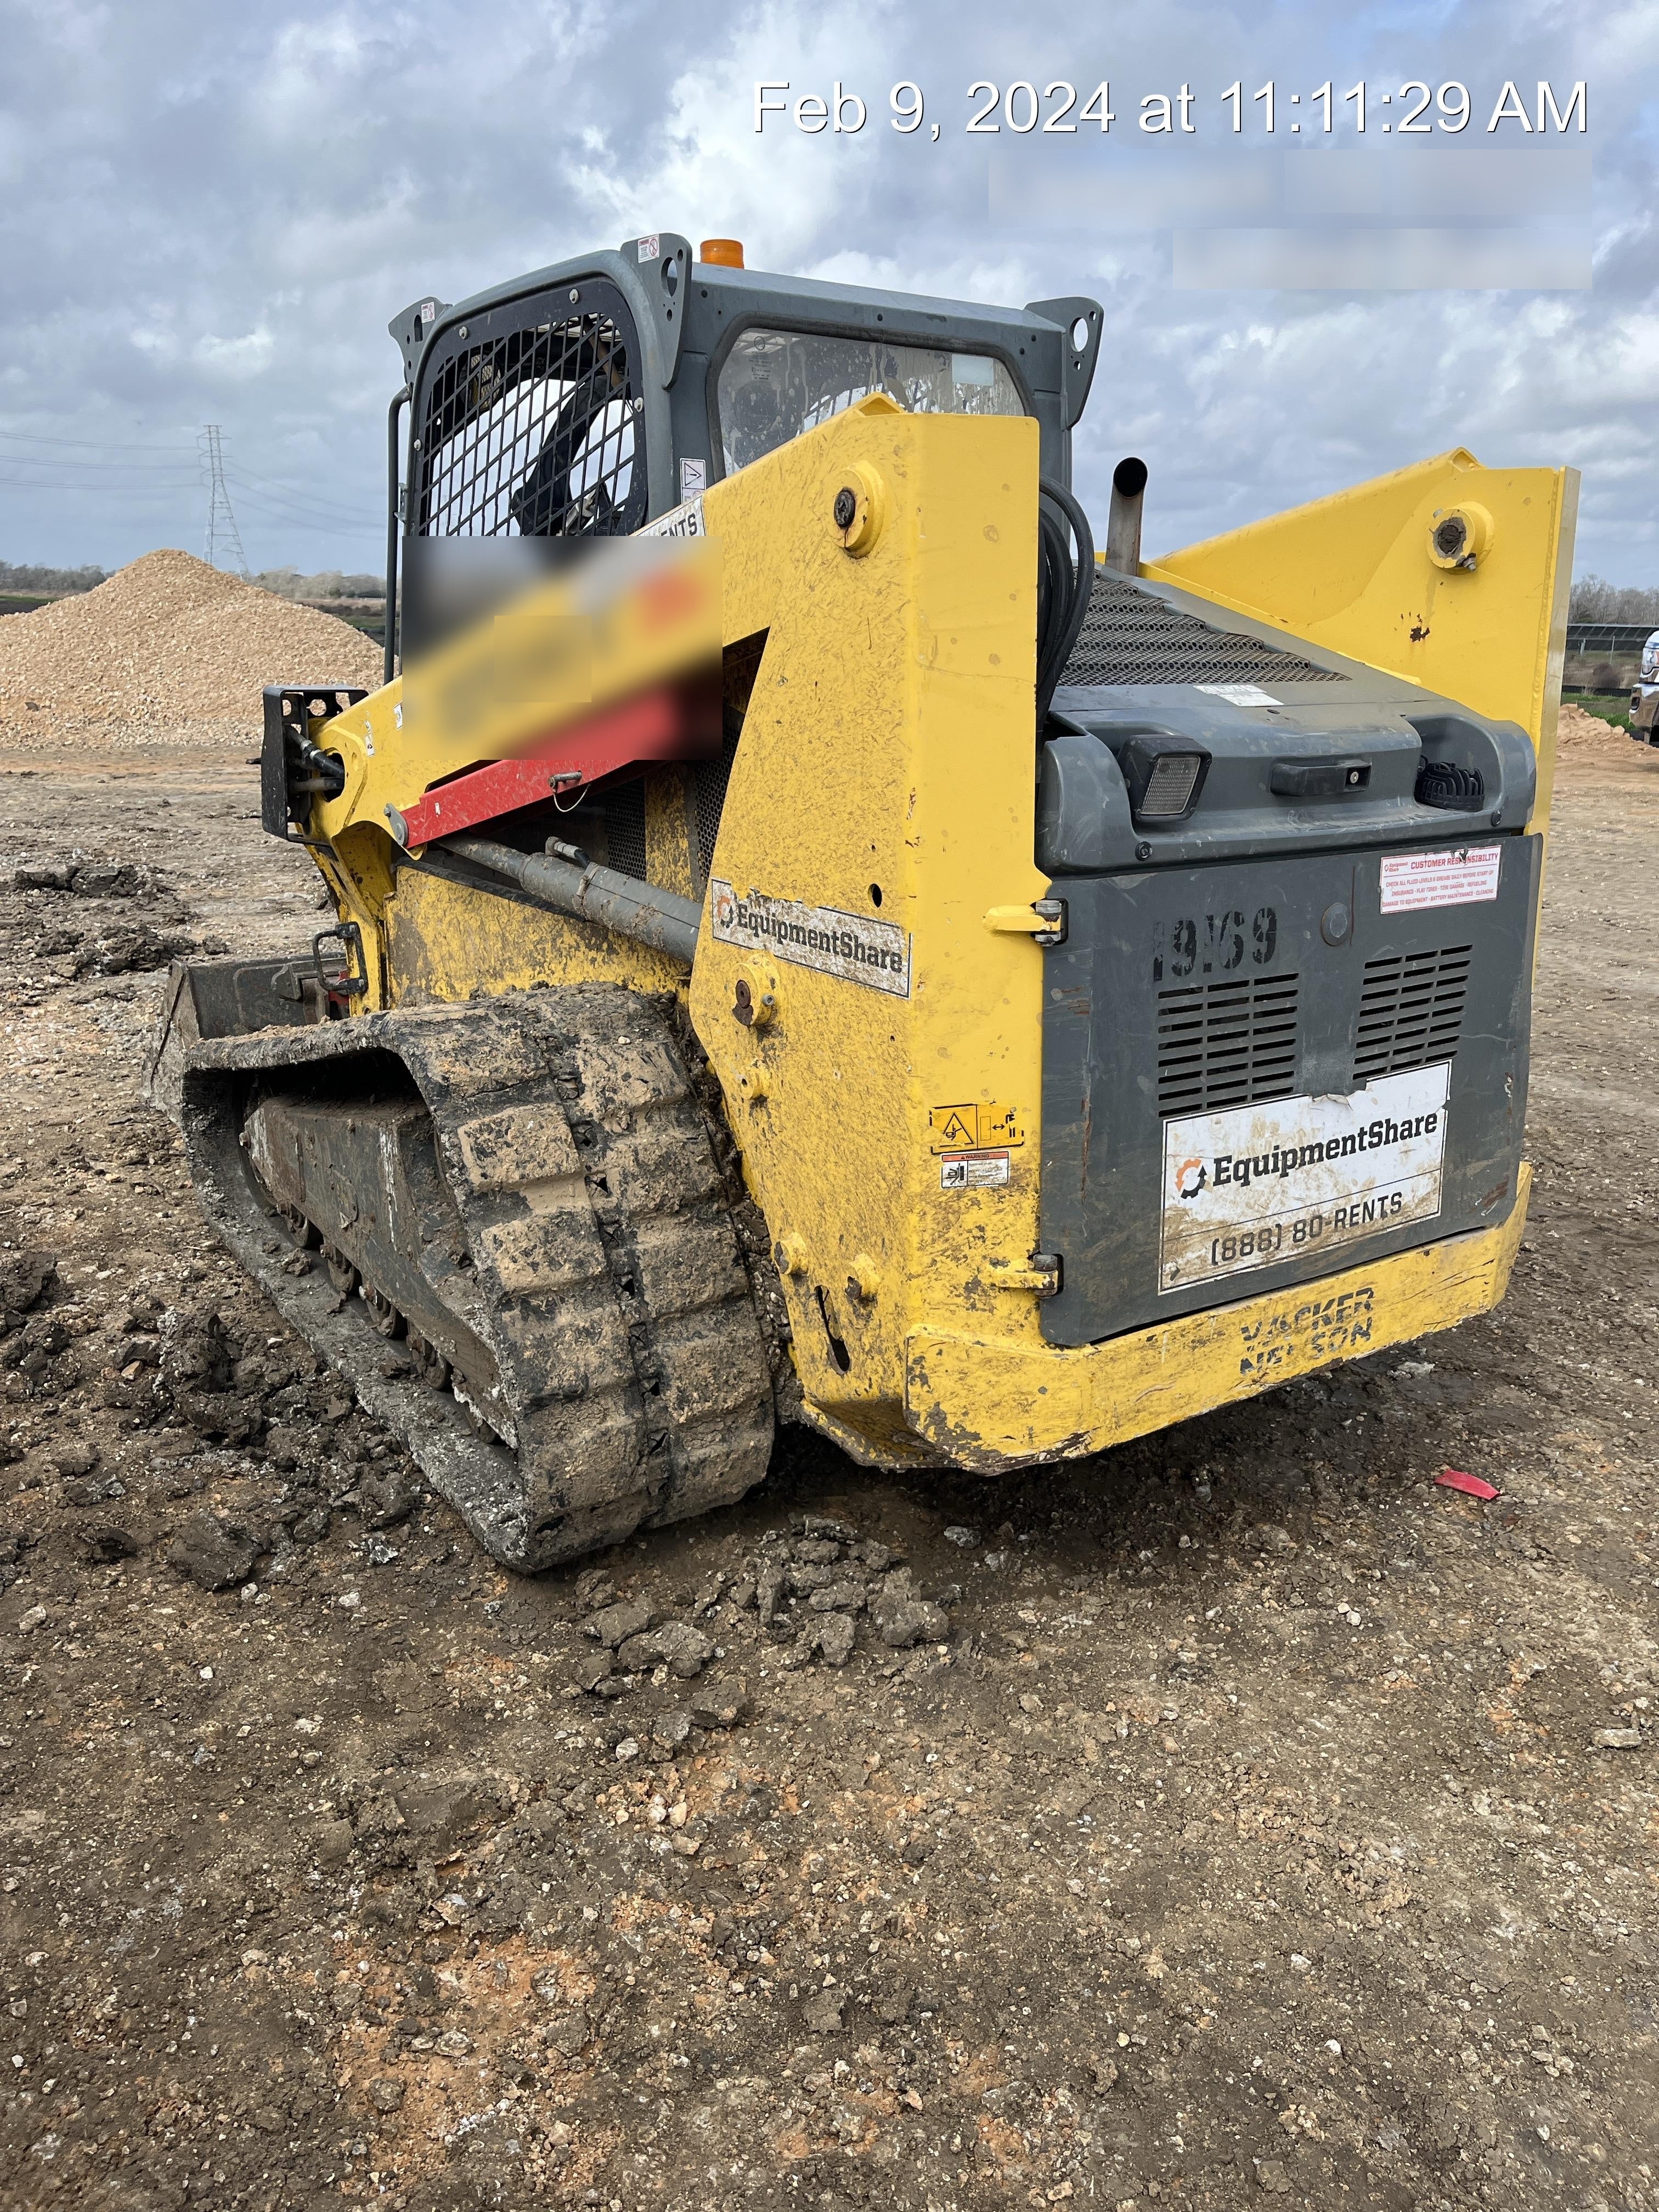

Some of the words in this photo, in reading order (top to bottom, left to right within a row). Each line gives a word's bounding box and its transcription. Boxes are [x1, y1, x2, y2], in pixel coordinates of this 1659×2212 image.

[1410, 857, 1446, 870] CUSTOMER
[1447, 891, 1474, 899] MAINTENANCE
[736, 903, 902, 974] EquipmentShare
[1212, 1112, 1438, 1187] EquipmentShare
[1211, 1223, 1282, 1266] (888)
[1292, 1192, 1403, 1244] 80-RENTS
